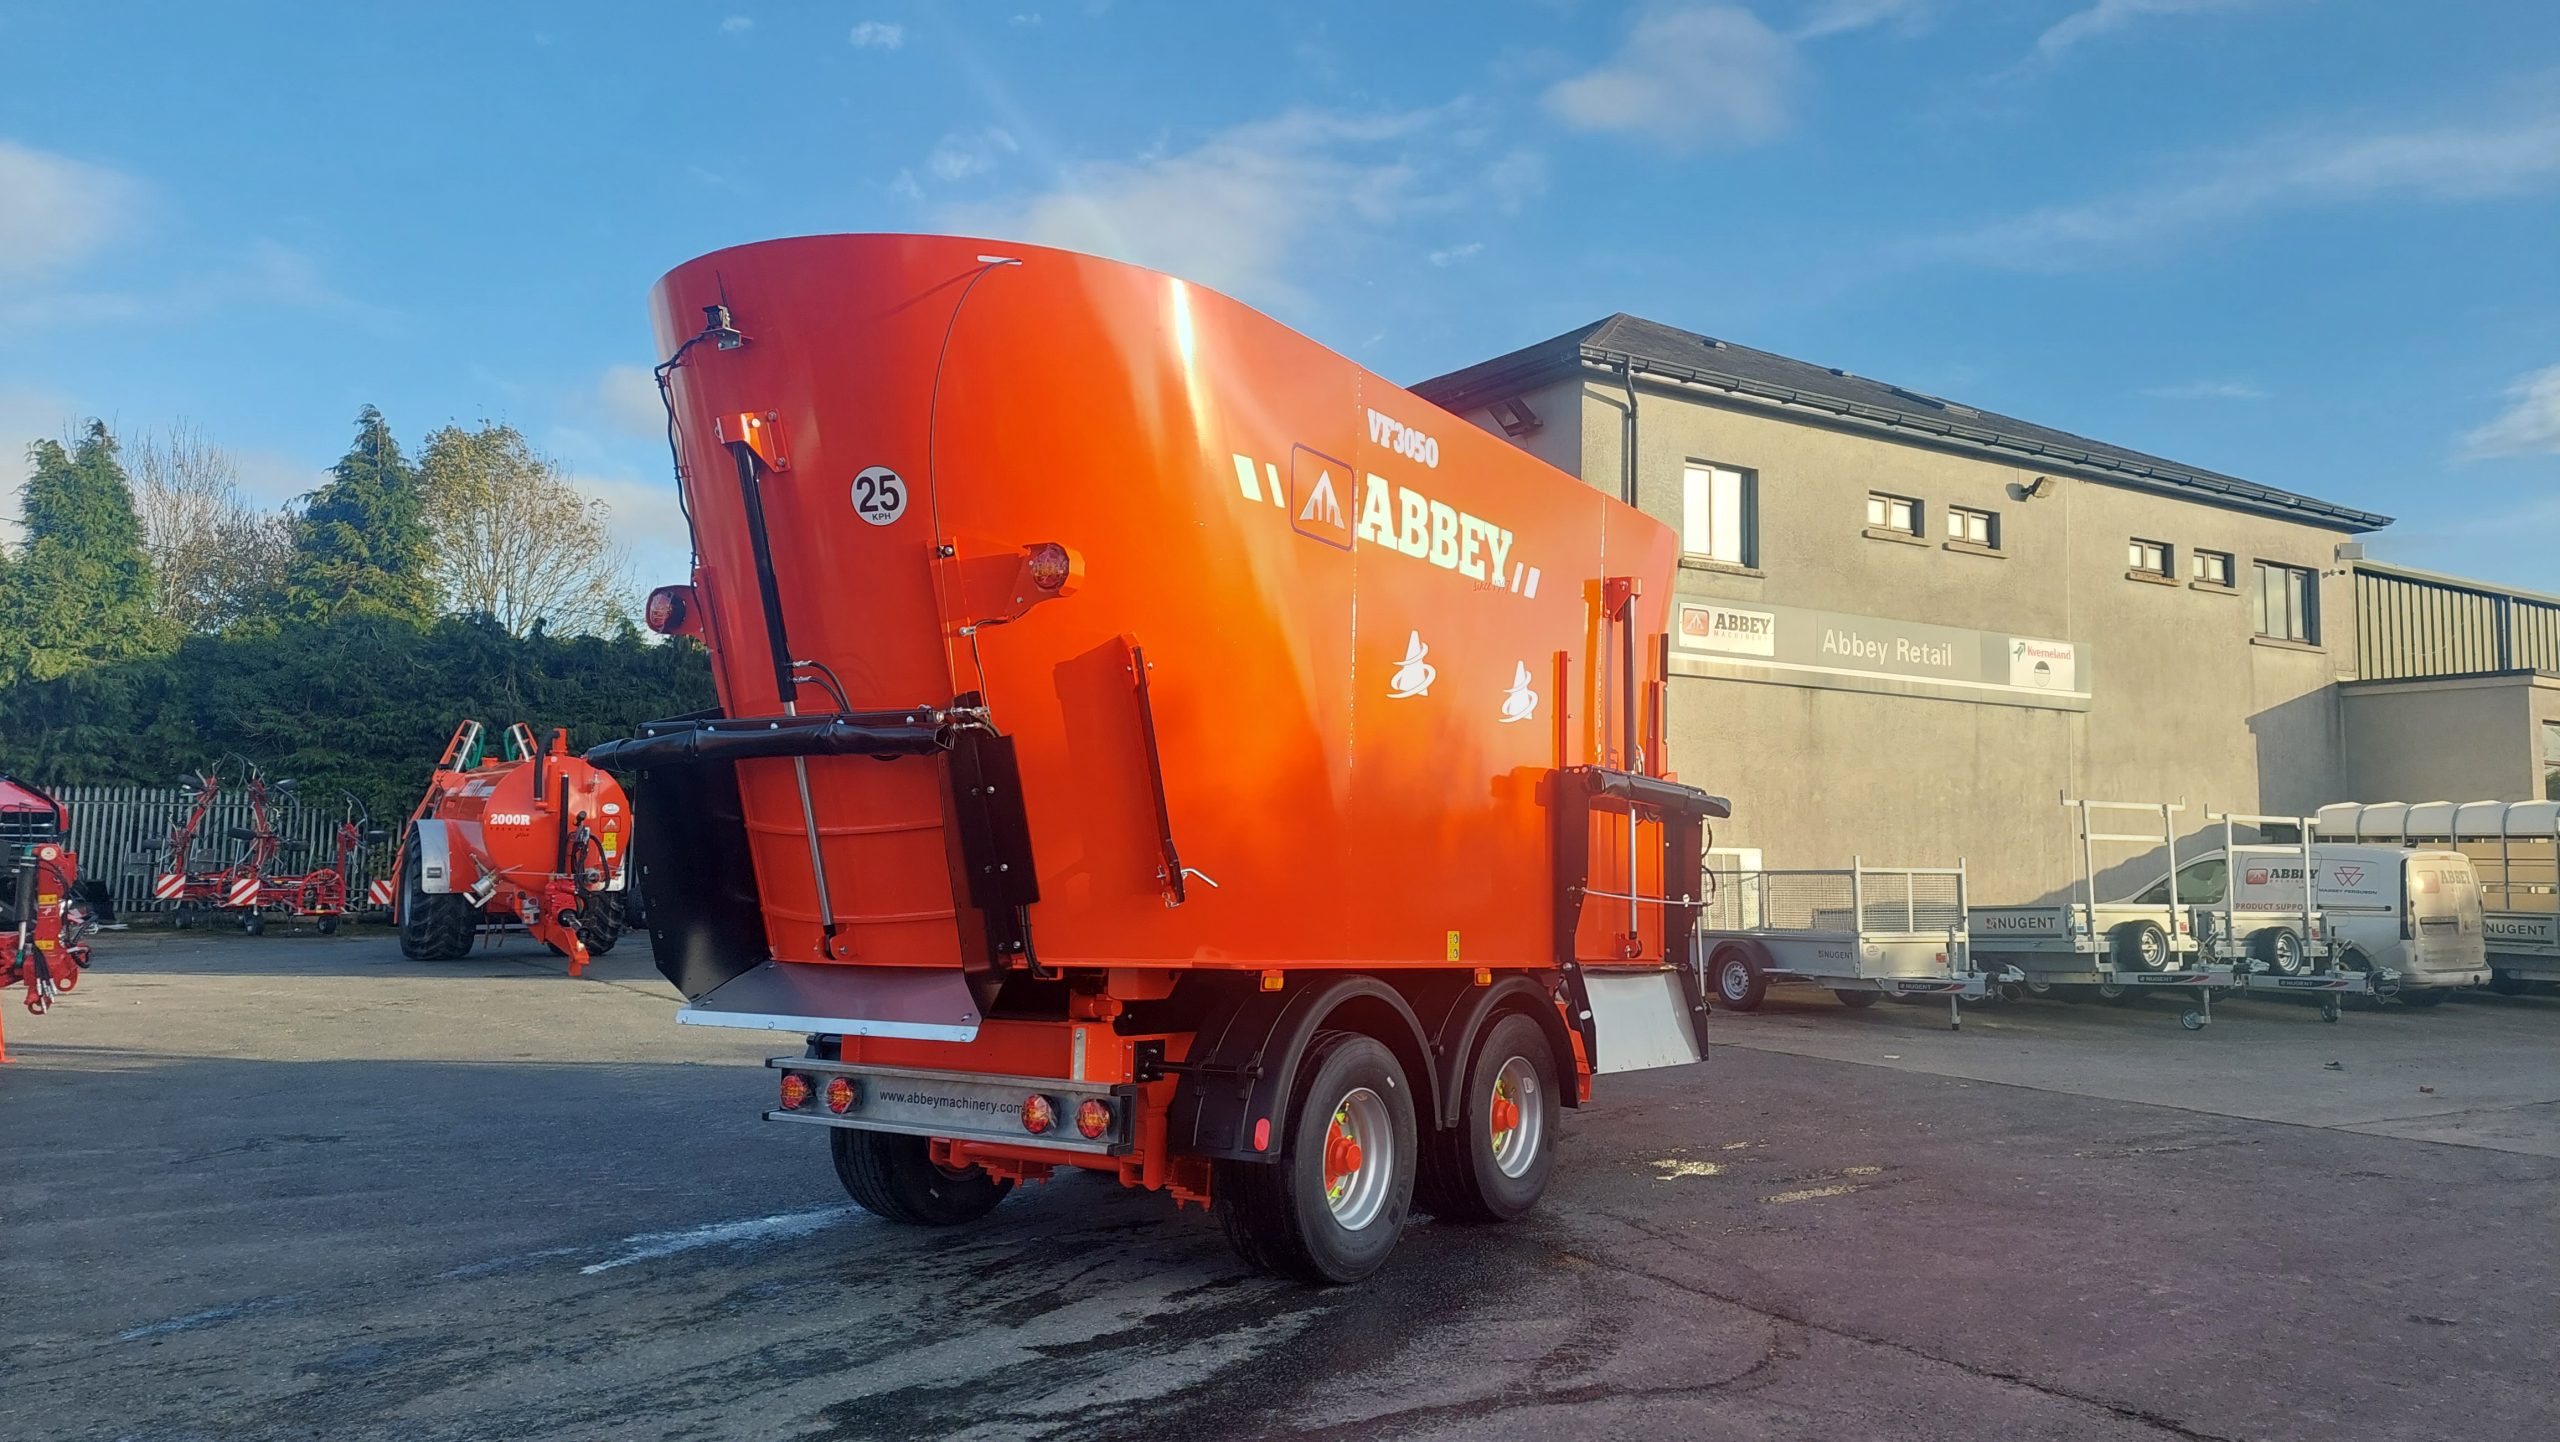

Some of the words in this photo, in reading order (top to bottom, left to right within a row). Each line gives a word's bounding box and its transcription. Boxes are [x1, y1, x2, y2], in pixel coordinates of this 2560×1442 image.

[1367, 407, 1439, 469] VF3050
[857, 474, 900, 513] 25
[872, 512, 892, 521] KPH
[1358, 472, 1513, 589] ABBEY
[1714, 612, 1771, 635] ABBEY
[1822, 628, 1889, 666] Abbey
[1896, 637, 1952, 667] Retail
[2027, 645, 2072, 661] Kverneland
[490, 813, 531, 826] 2000R
[2441, 870, 2471, 885] ABBEY
[2235, 902, 2274, 911] PRODUCT
[1999, 917, 2056, 929] NUGENT
[2485, 923, 2547, 936] NUGENT
[879, 1090, 1023, 1115] www.abbeymachinery.com
